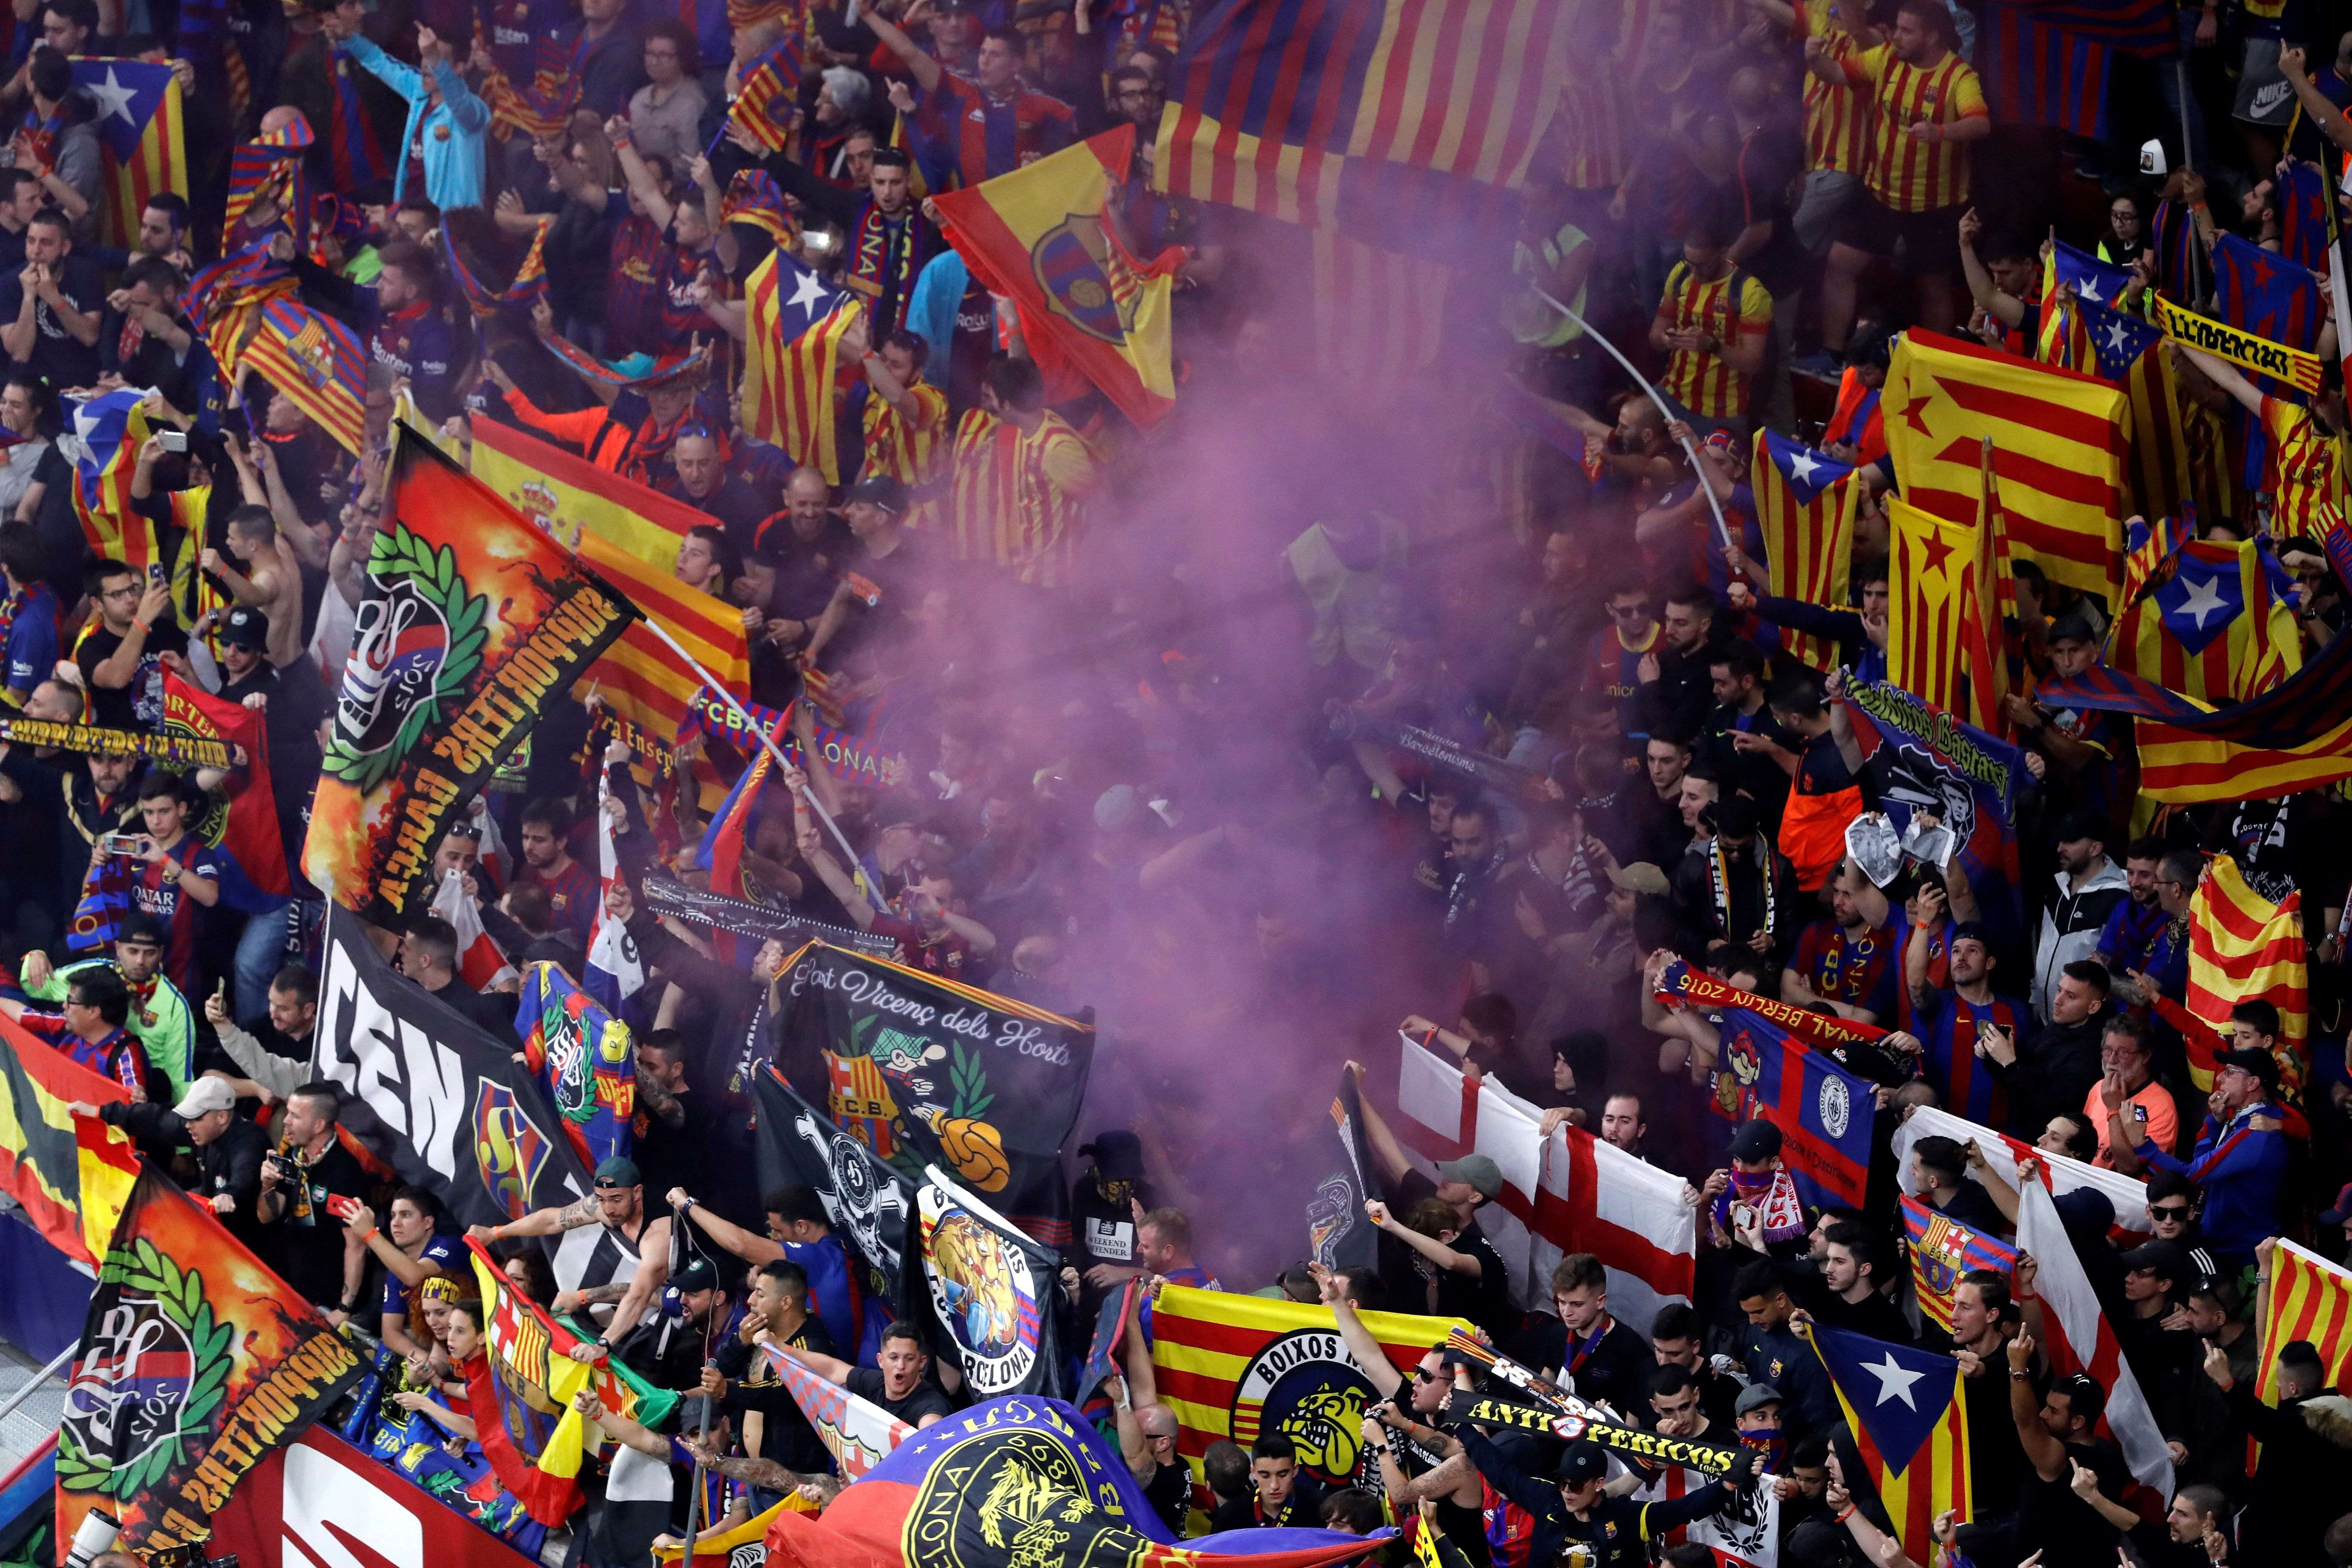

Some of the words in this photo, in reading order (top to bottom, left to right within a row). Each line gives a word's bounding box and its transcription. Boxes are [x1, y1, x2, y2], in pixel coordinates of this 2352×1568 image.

[2256, 80, 2289, 104] NIKE
[132, 885, 174, 906] QATAR
[1676, 973, 1727, 998] 2015
[1730, 991, 1803, 1026] BERLIN
[940, 1006, 992, 1040] dels
[995, 1020, 1071, 1067] Horts
[1088, 1236, 1127, 1249] WEEKEND
[1256, 1335, 1338, 1385] BOIXOS
[1468, 1399, 1550, 1433] ANTI
[1586, 1422, 1737, 1473] PERICOS
[1698, 1463, 1722, 1477] 100%
